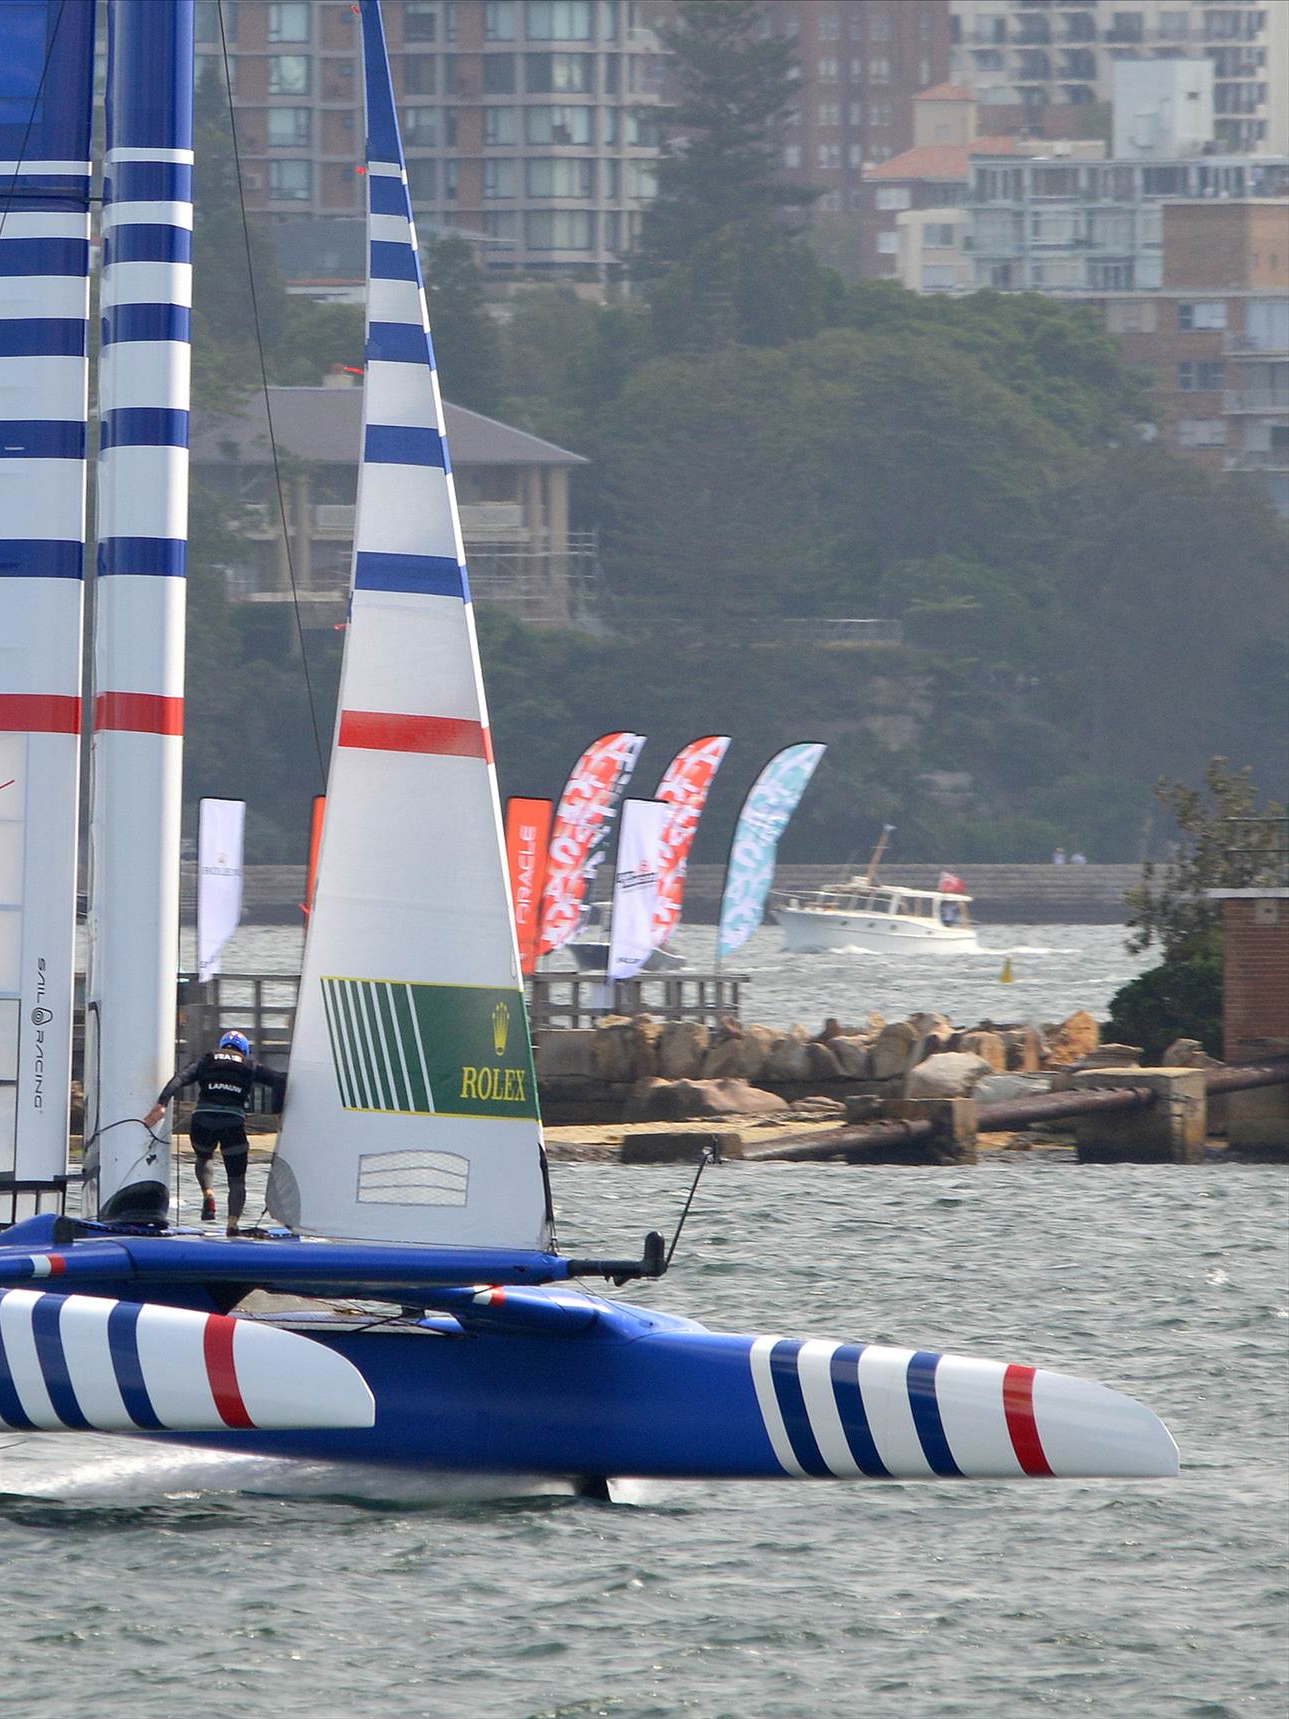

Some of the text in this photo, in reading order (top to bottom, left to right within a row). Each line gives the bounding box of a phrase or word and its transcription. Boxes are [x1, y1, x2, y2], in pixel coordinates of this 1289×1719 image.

[34, 957, 46, 1108] SAIL RACING
[460, 1066, 526, 1102] ROLEX
